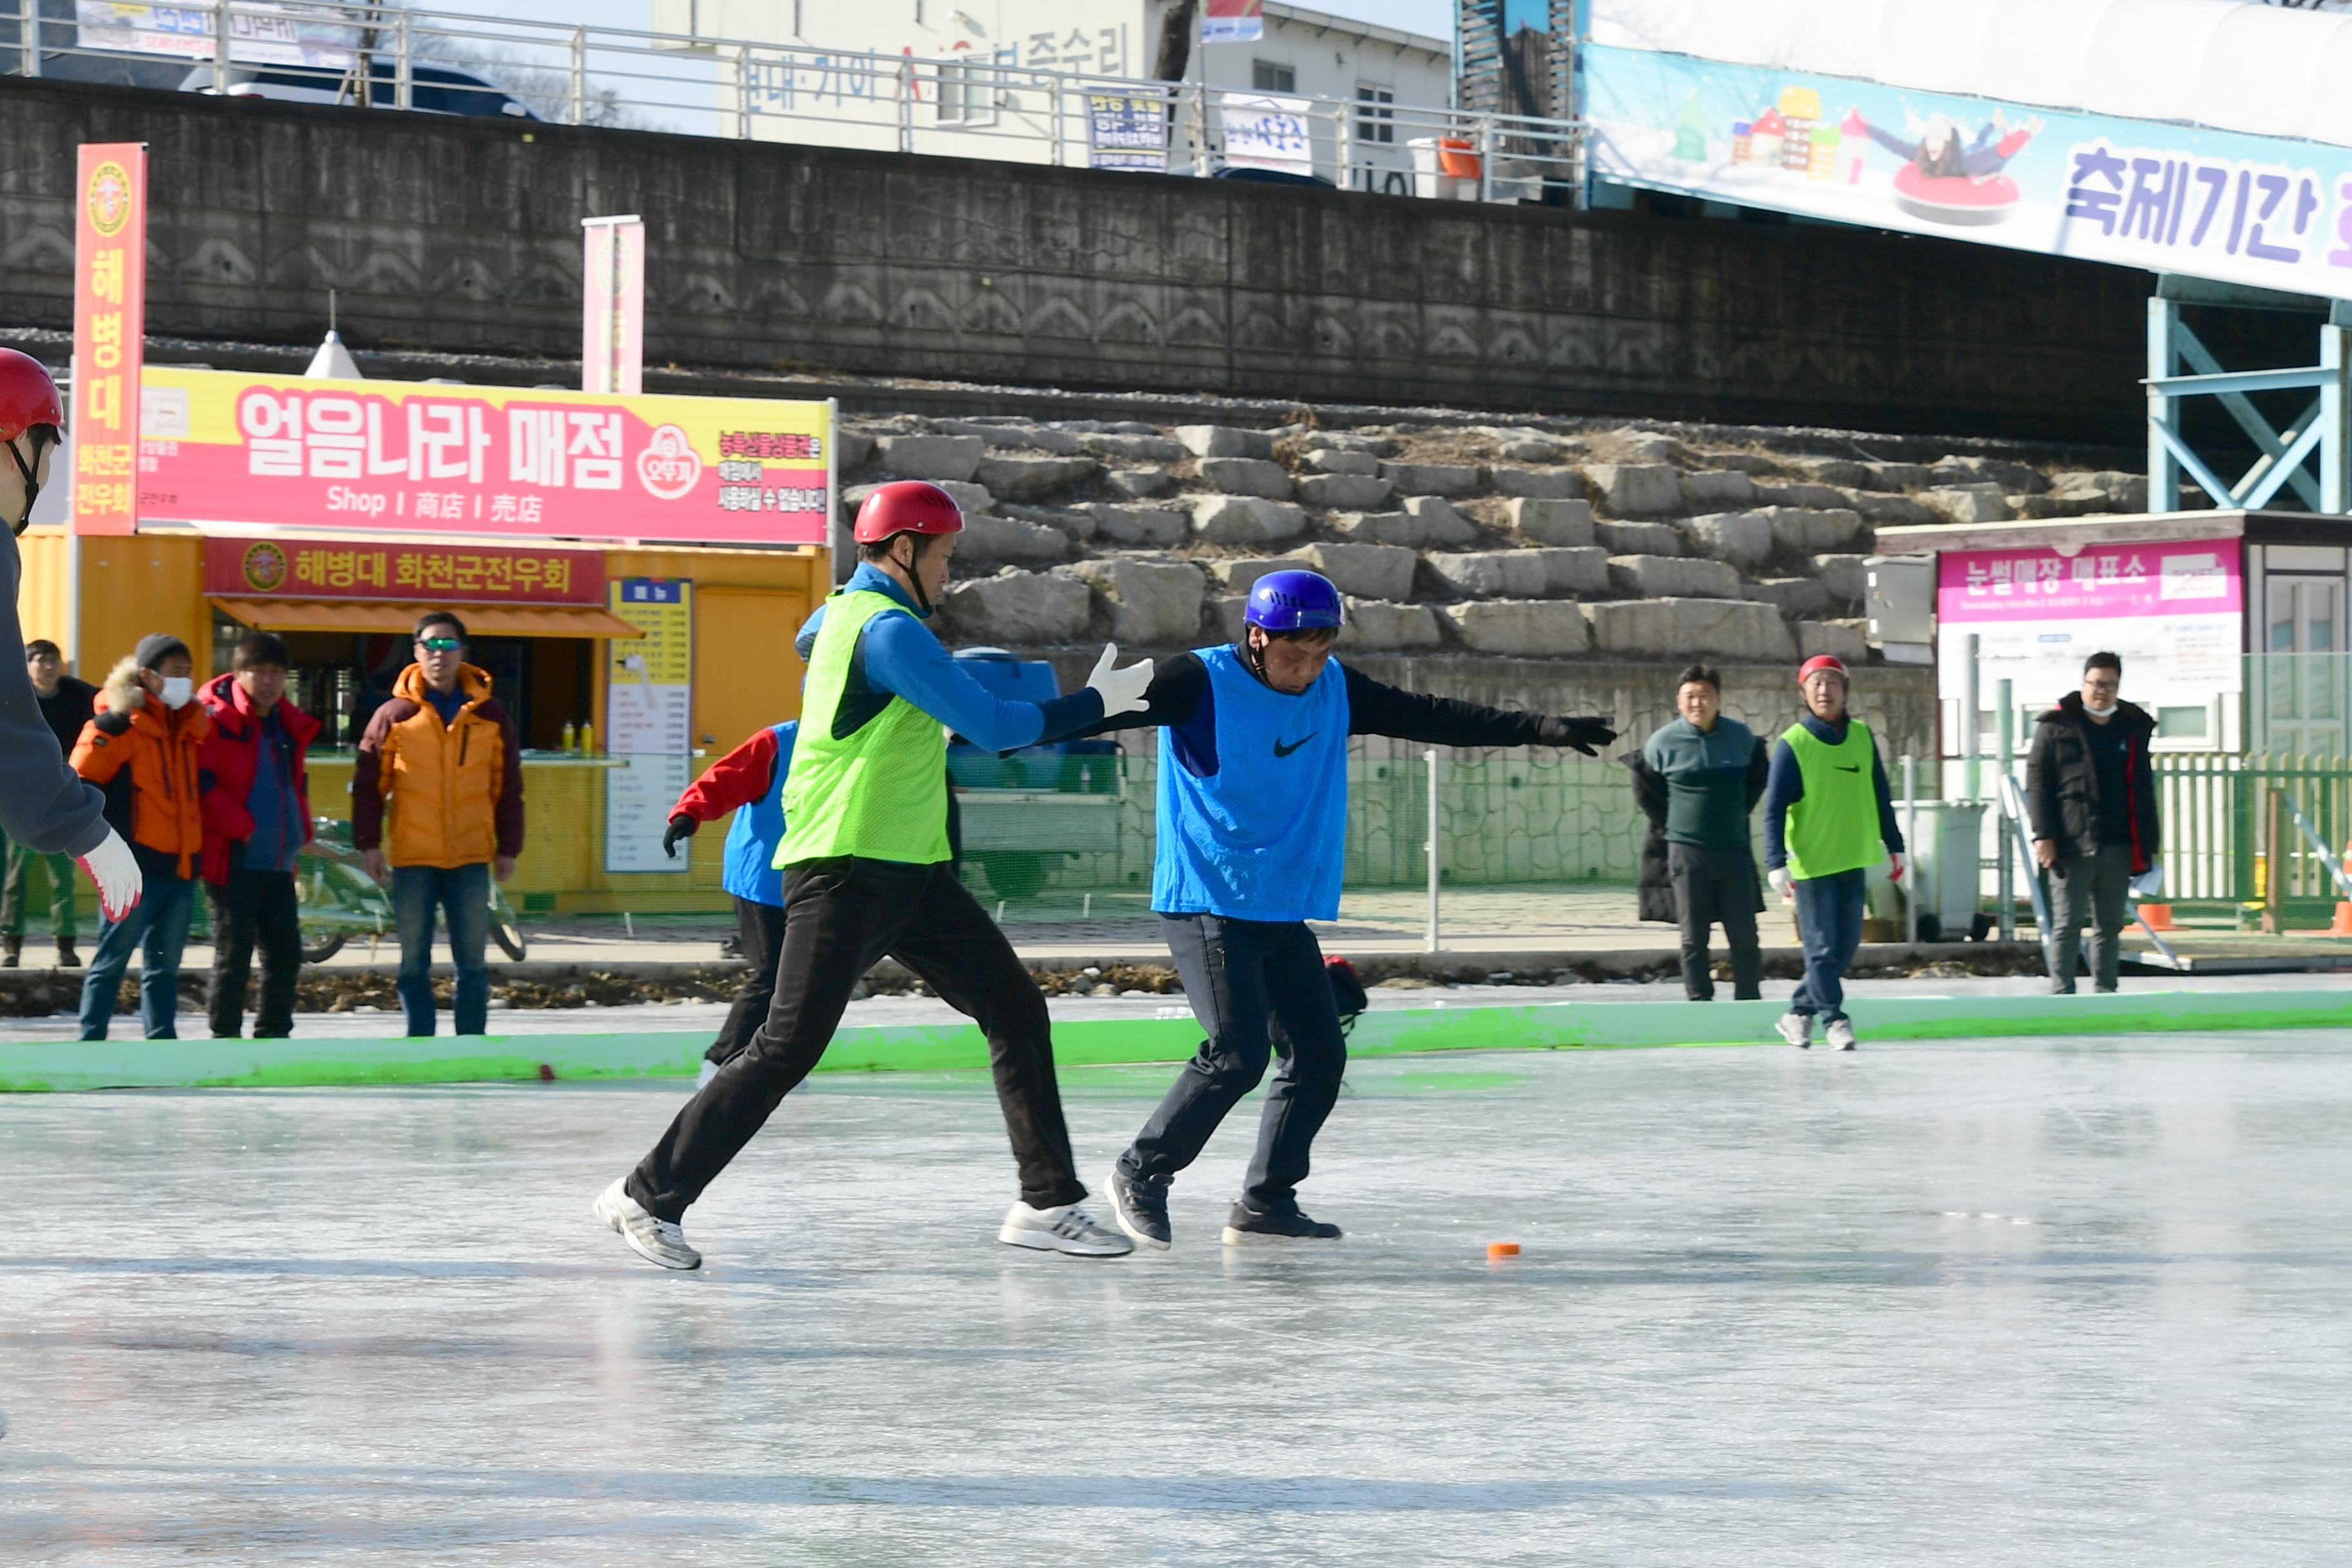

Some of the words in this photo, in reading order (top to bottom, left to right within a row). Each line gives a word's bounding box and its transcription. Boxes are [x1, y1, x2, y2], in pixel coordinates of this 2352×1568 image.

[2065, 147, 2317, 264] 축제기간
[88, 248, 124, 431] 해병대
[241, 393, 492, 484] 얼음나라
[508, 408, 623, 491] 매점
[77, 444, 132, 476] 화천군
[647, 458, 692, 482] 오뚜기
[76, 483, 132, 515] 전우회
[326, 485, 386, 518] Shop
[416, 491, 466, 520] 商店
[491, 493, 544, 524] 売店
[763, 486, 778, 513] 수
[295, 549, 386, 588] 해병대
[395, 553, 571, 594] 화천군전우회
[1965, 557, 2064, 597] 눈썰매장
[2071, 554, 2148, 593] 매표소
